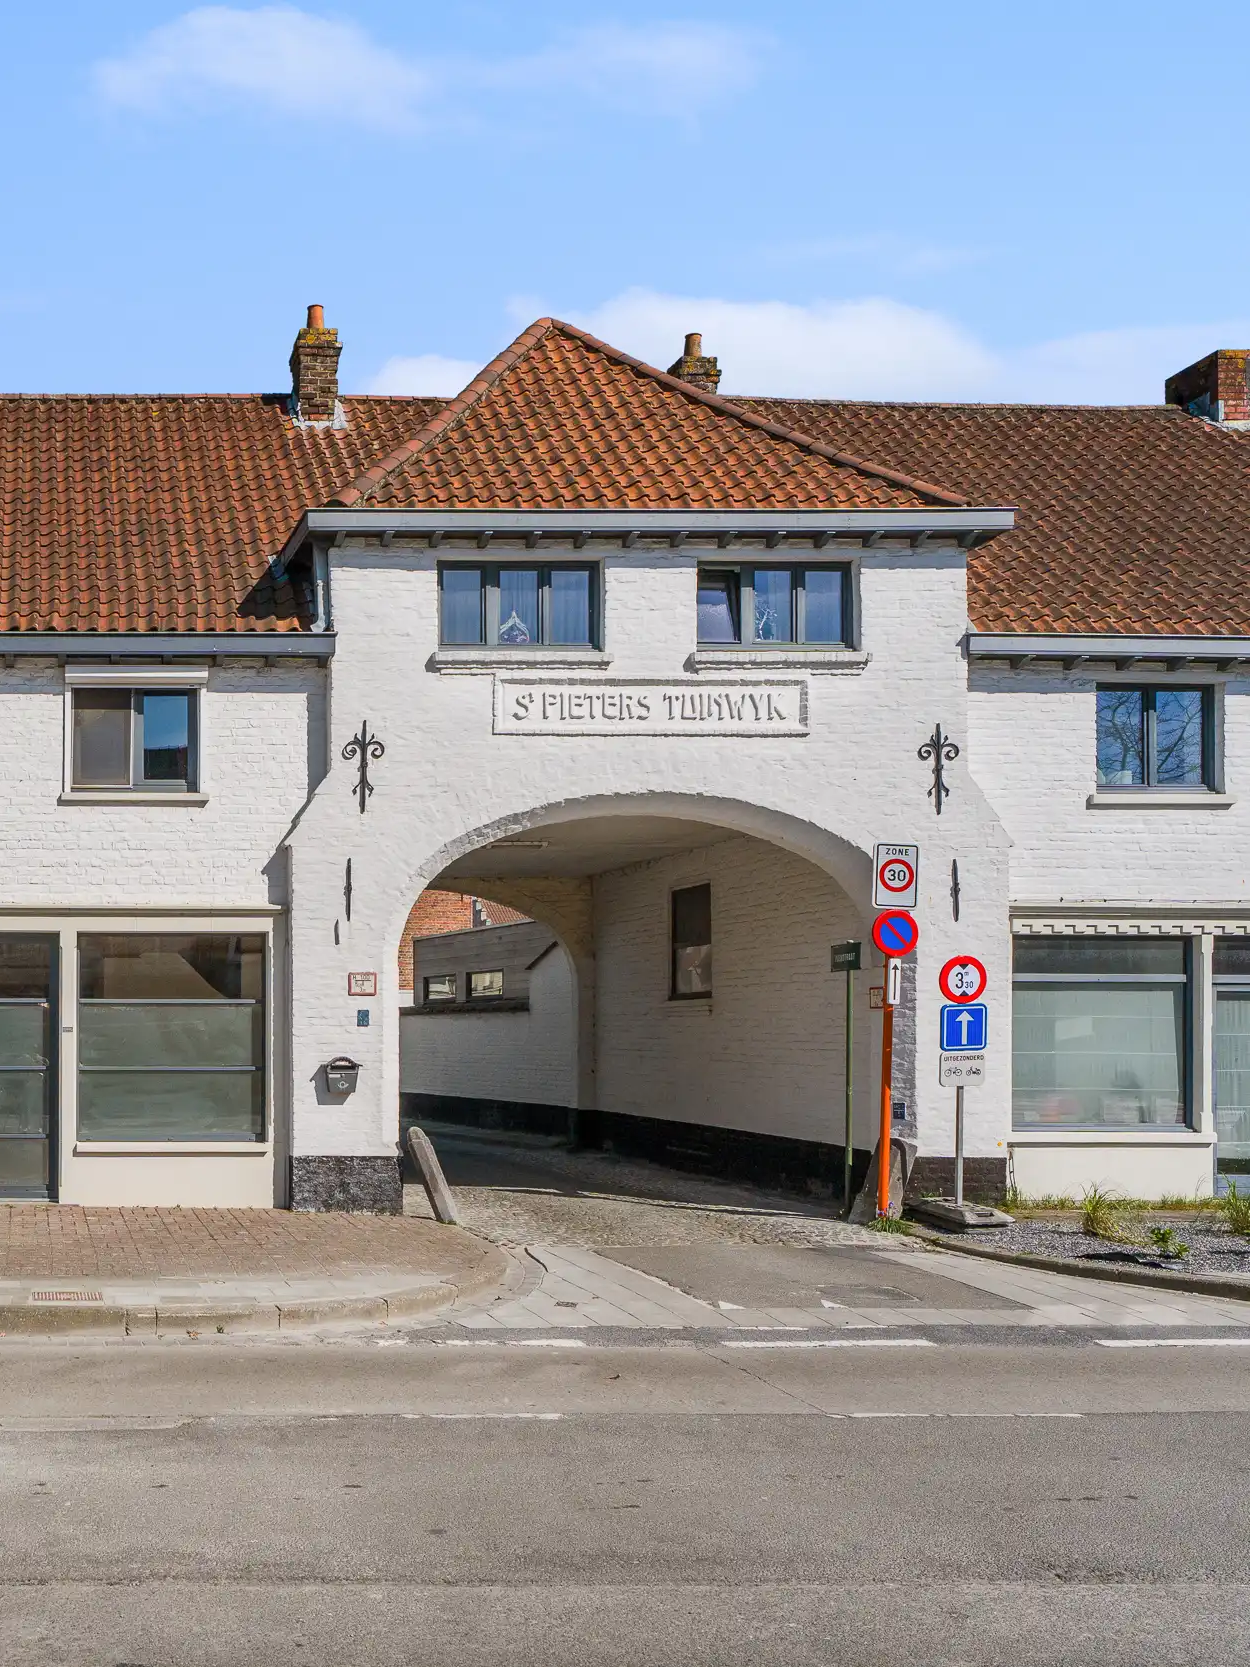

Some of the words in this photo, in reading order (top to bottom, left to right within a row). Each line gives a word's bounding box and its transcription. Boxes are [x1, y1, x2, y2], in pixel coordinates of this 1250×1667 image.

[541, 691, 651, 721] PIETERS
[885, 847, 910, 856] ZONE
[887, 868, 906, 882] 30
[943, 1054, 985, 1062] UITGEZONDERD
